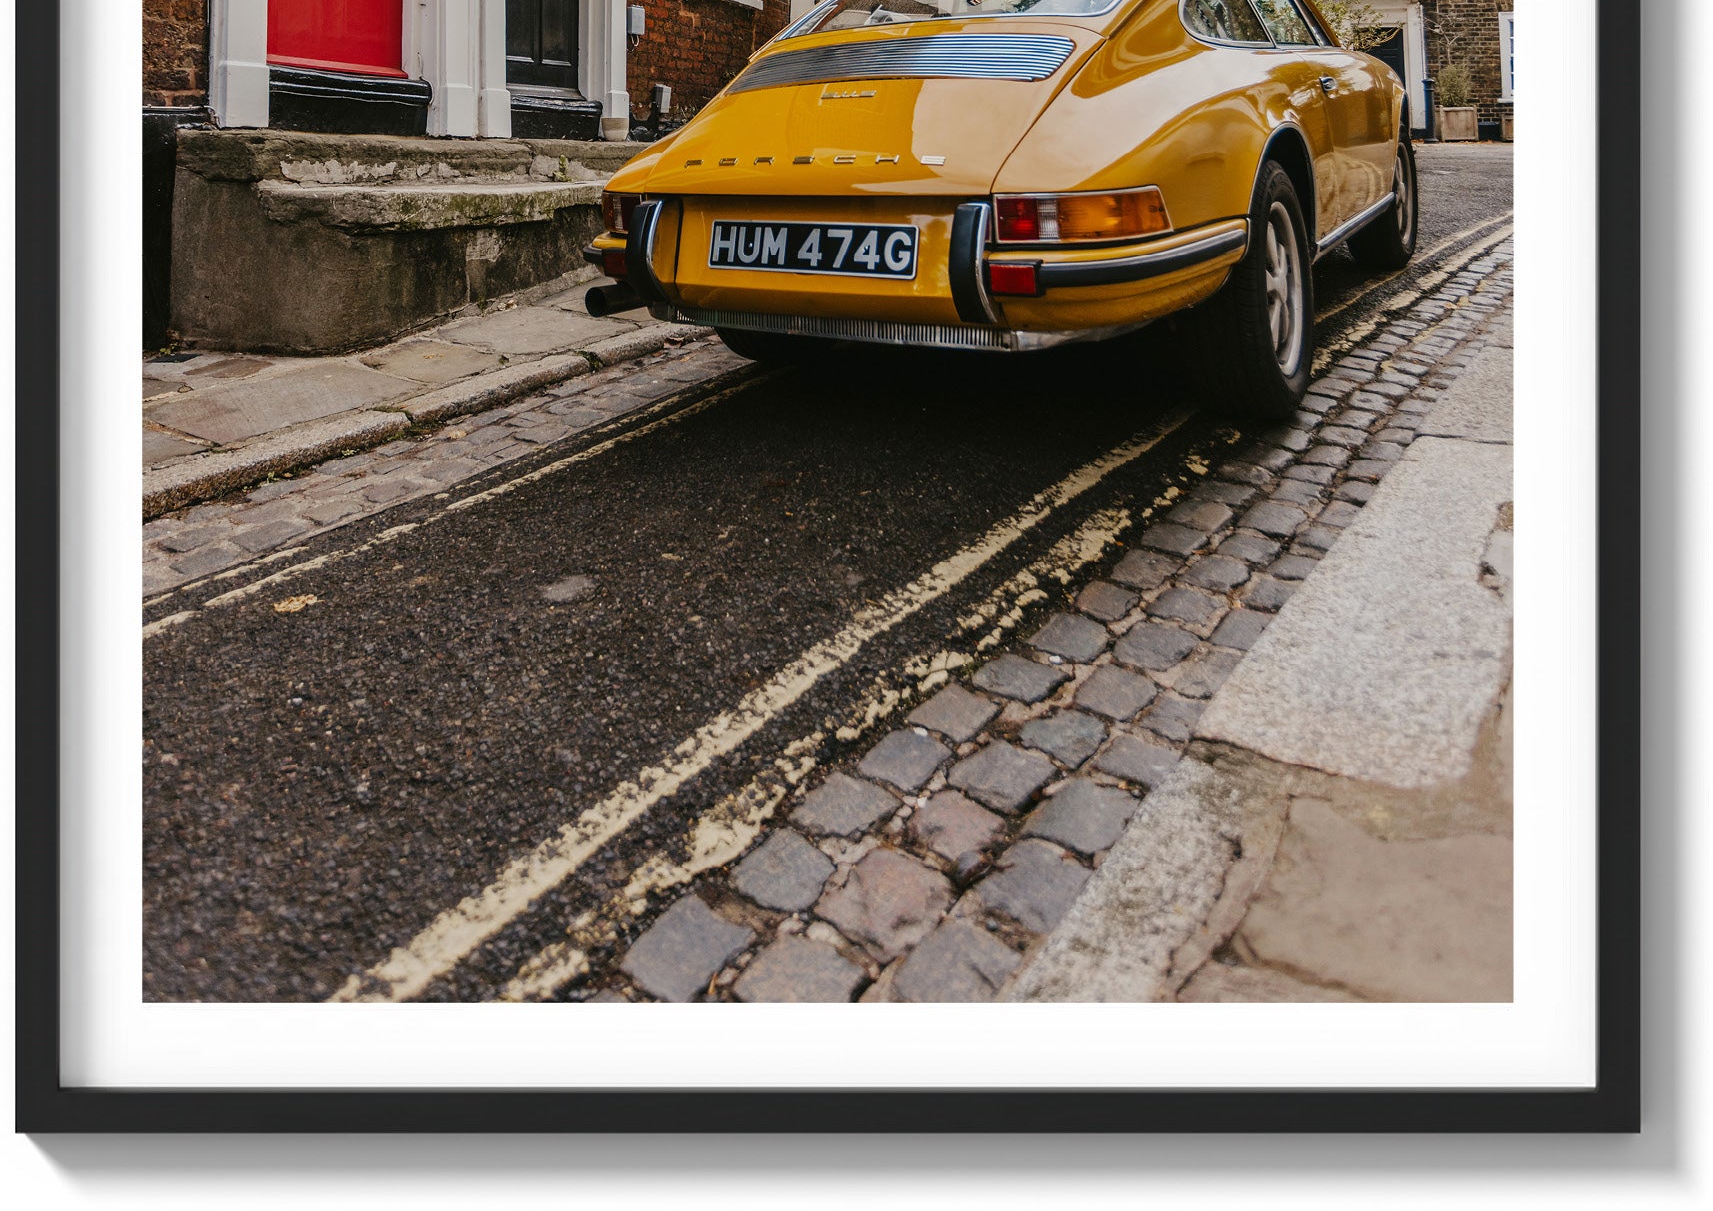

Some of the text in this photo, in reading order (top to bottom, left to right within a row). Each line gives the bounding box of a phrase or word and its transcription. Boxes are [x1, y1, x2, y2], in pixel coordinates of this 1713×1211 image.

[684, 154, 946, 168] PORSCHE
[712, 226, 912, 271] HUM 474G
